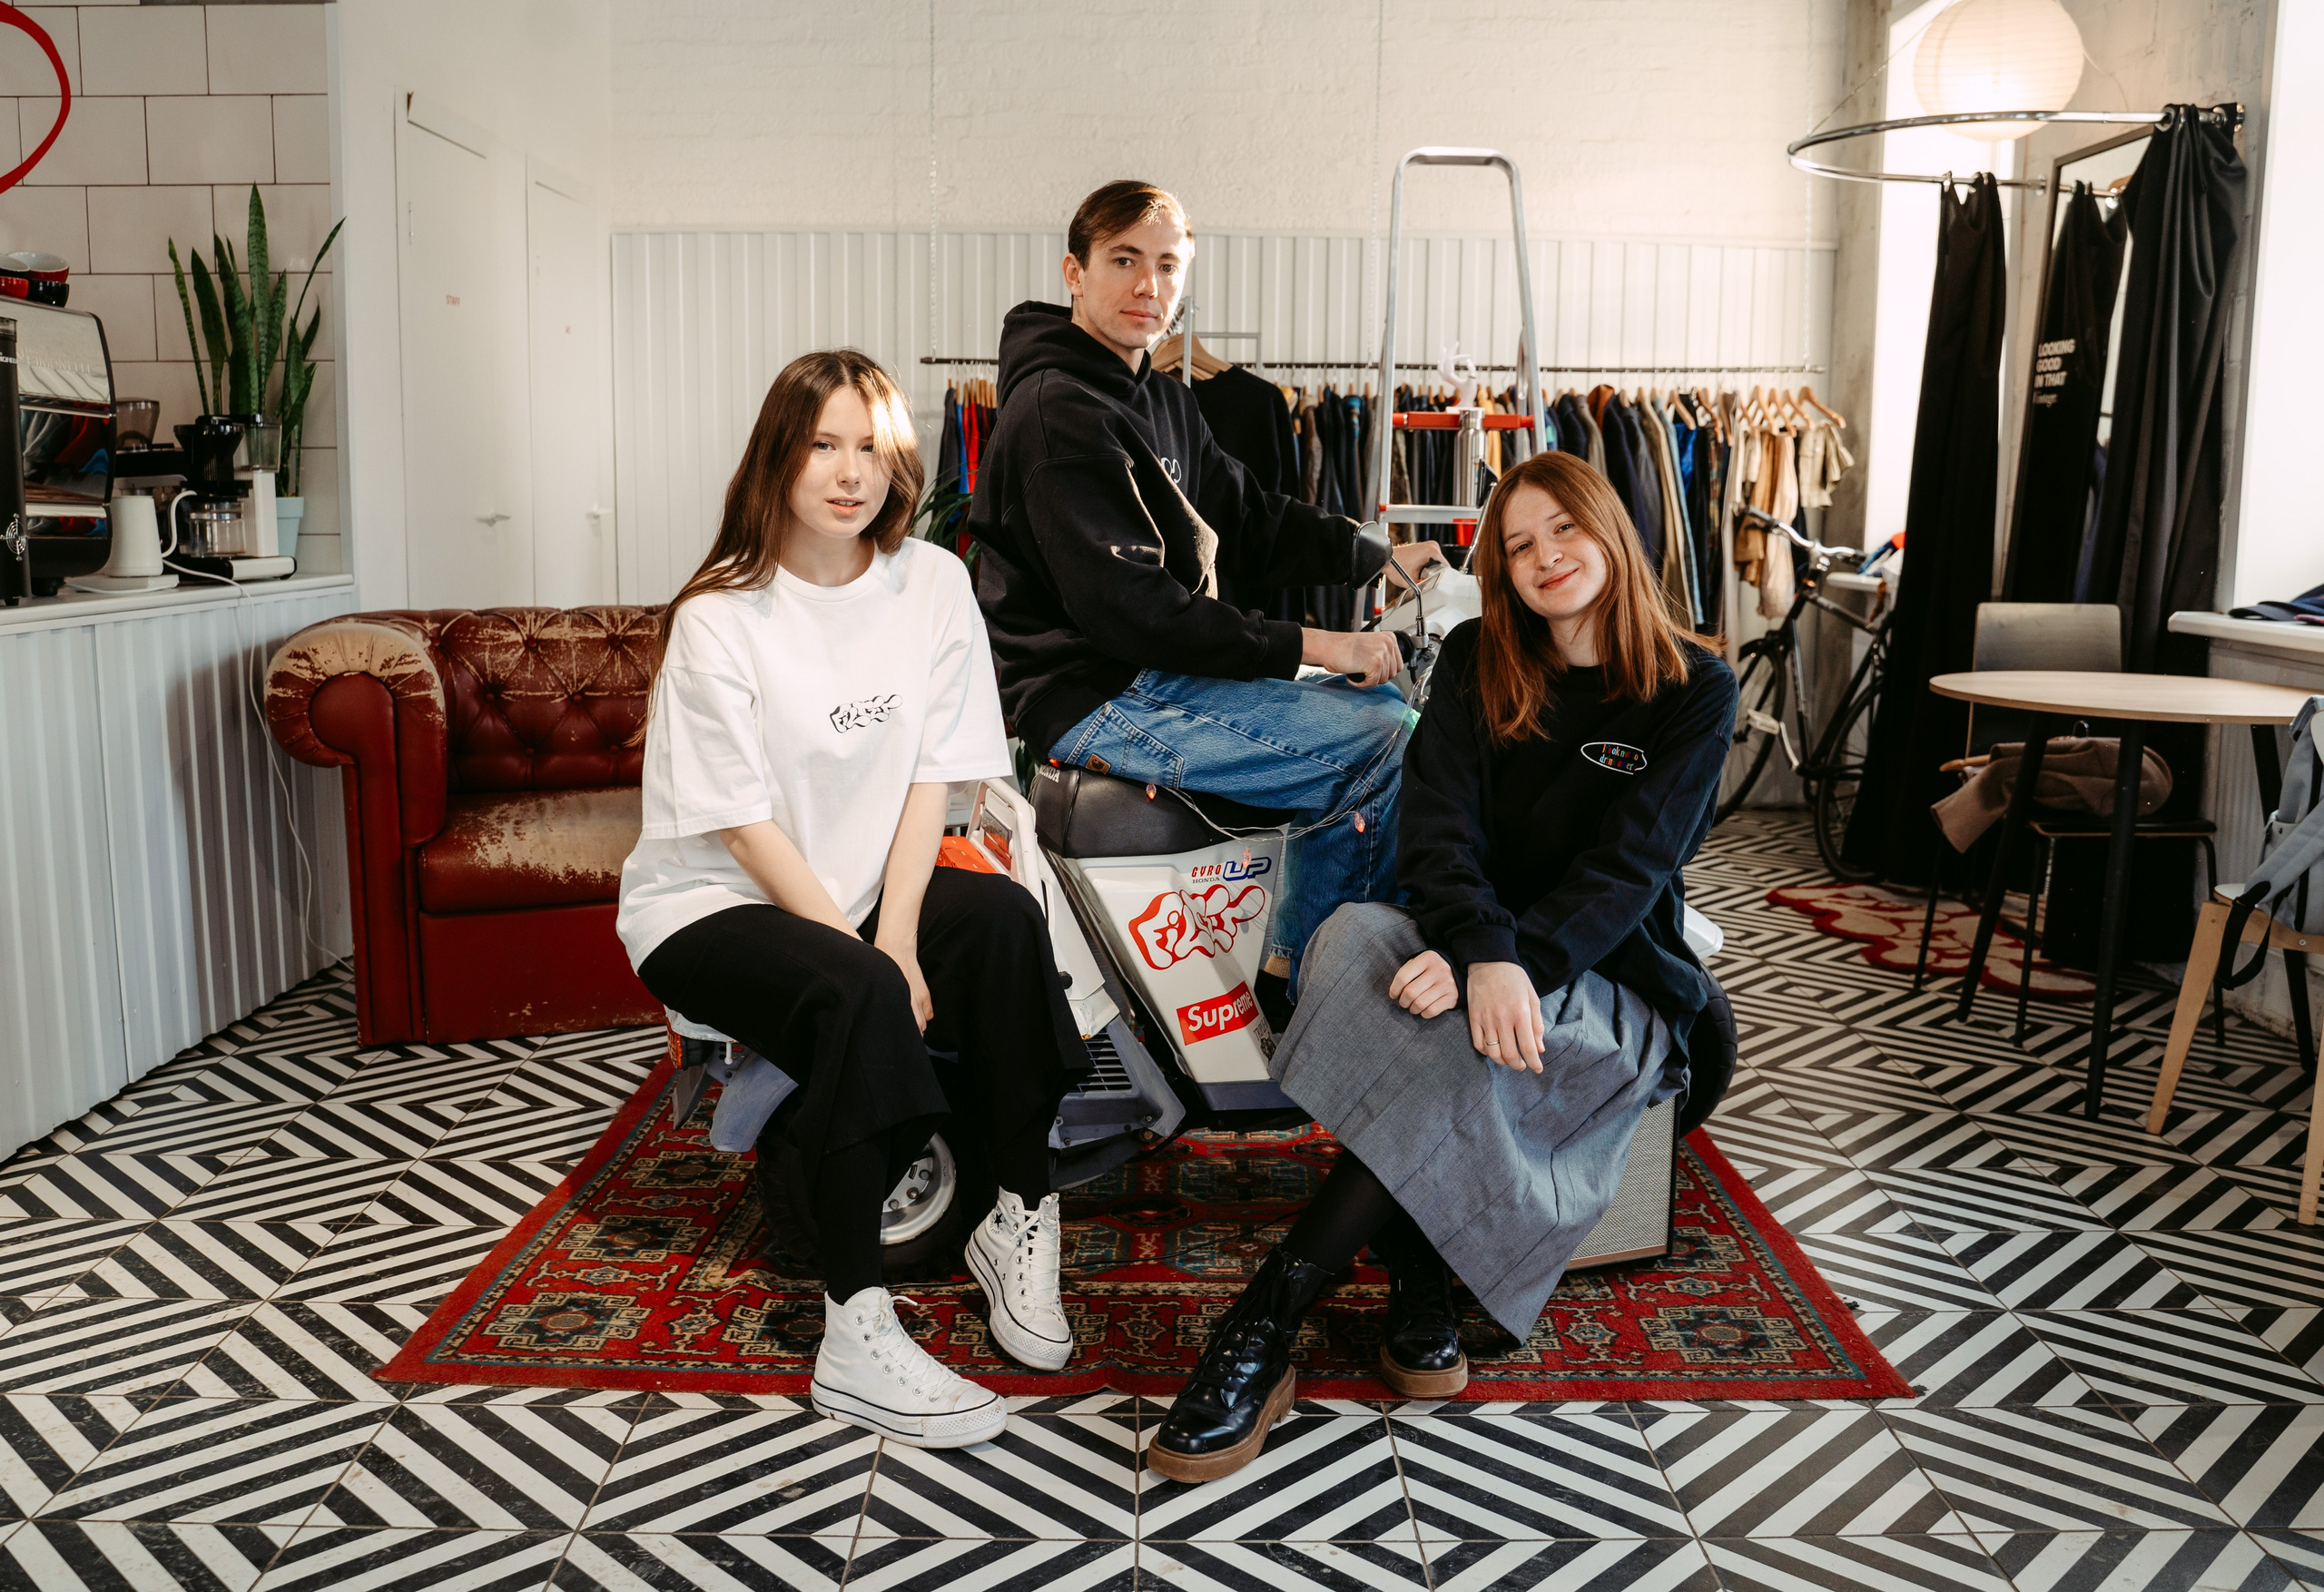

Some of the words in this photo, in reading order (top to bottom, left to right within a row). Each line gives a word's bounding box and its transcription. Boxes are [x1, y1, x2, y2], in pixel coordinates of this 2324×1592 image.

[2038, 339, 2075, 357] LOOKING
[2035, 357, 2063, 373] GOOD
[2034, 374, 2043, 388] IN
[2044, 371, 2067, 387] THAT
[1191, 864, 1222, 878] GYRO
[1223, 856, 1272, 881] UP
[1187, 990, 1253, 1032] Supreme
